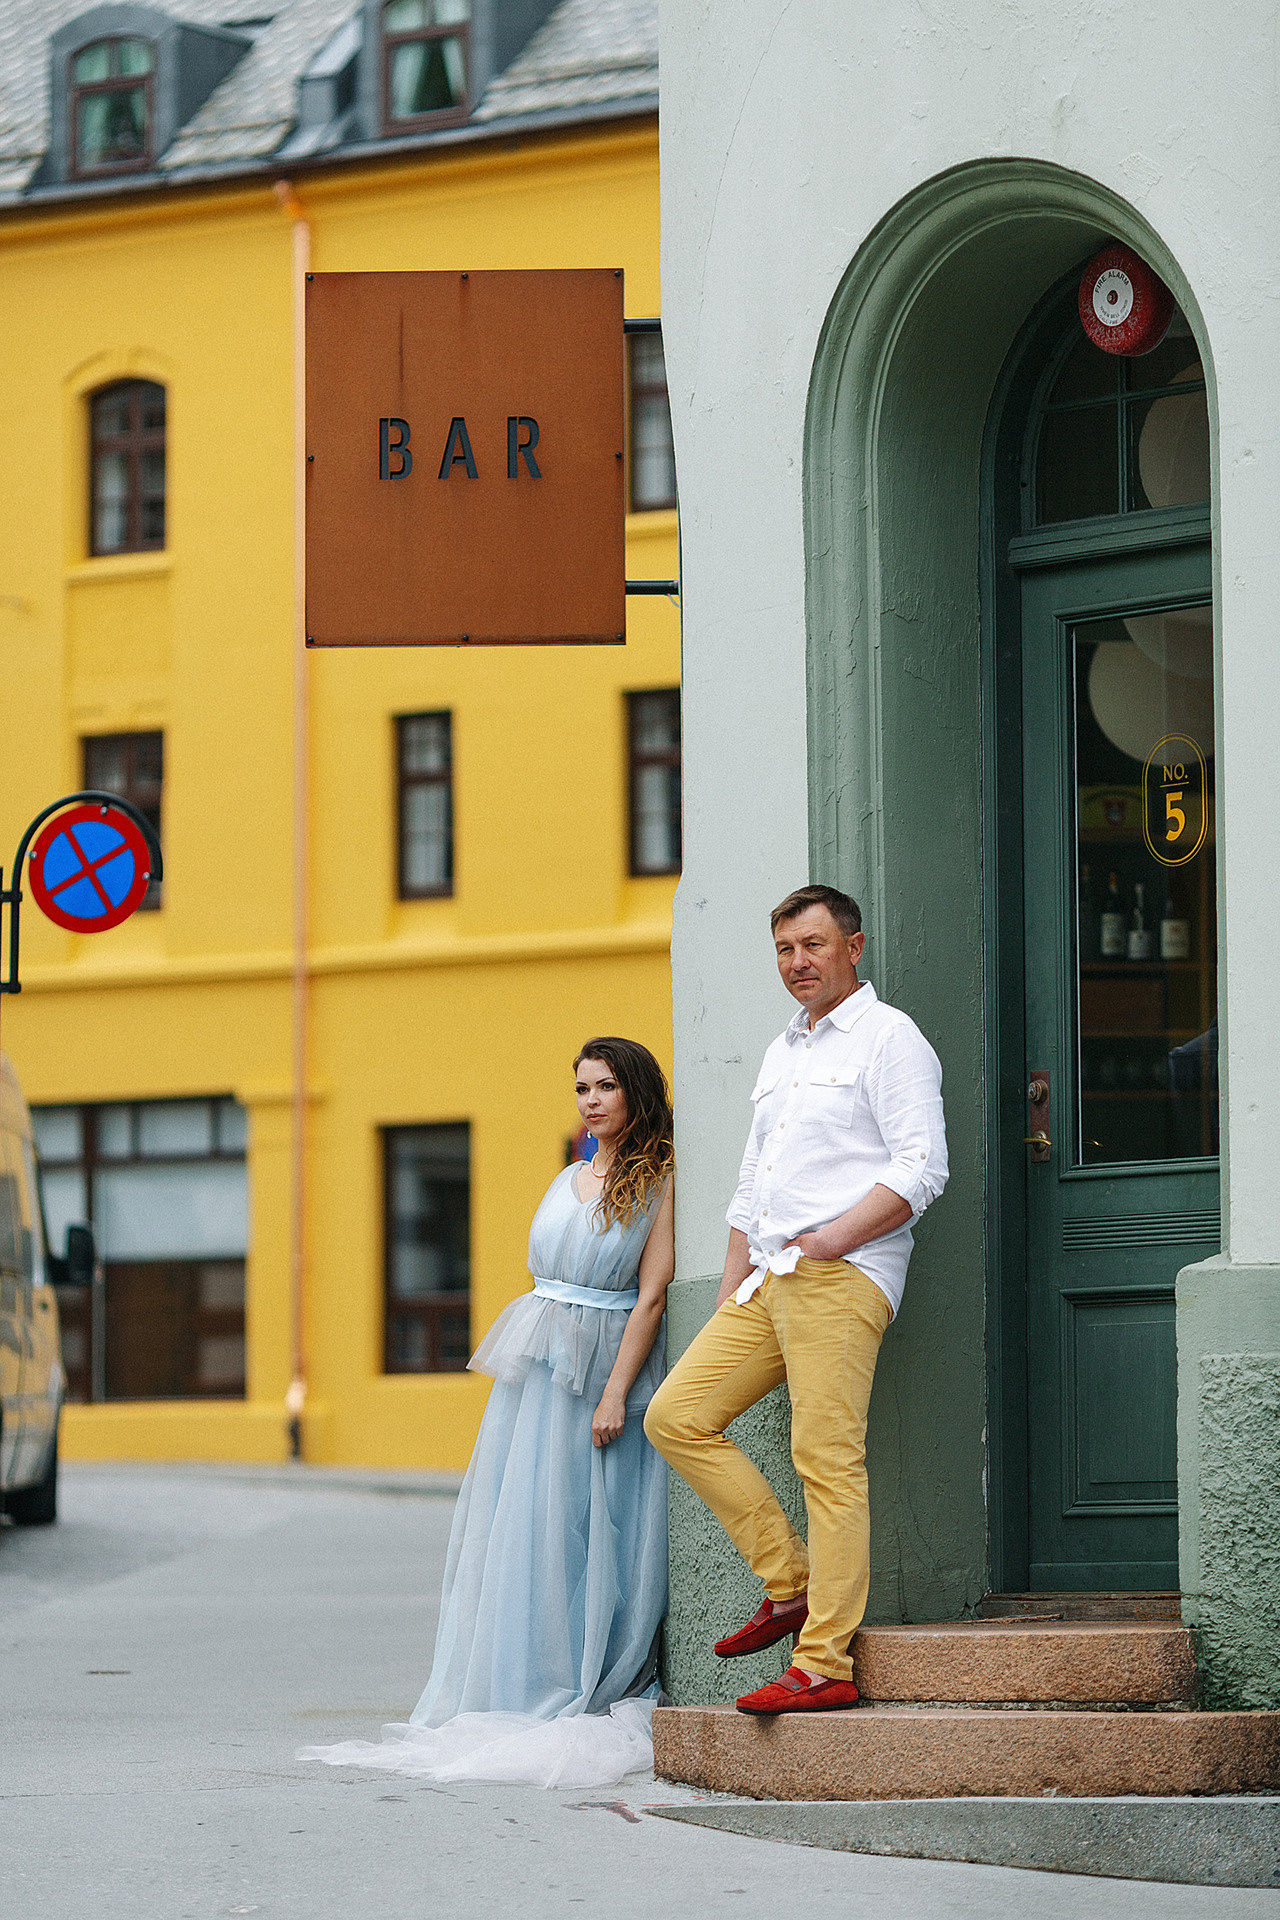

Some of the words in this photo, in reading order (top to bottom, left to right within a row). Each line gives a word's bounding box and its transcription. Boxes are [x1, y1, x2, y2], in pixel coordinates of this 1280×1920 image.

[1095, 274, 1107, 294] FIRE
[1108, 270, 1130, 287] ALARM
[379, 416, 543, 481] BAR
[1163, 762, 1188, 782] NO.
[1165, 791, 1186, 842] 5
